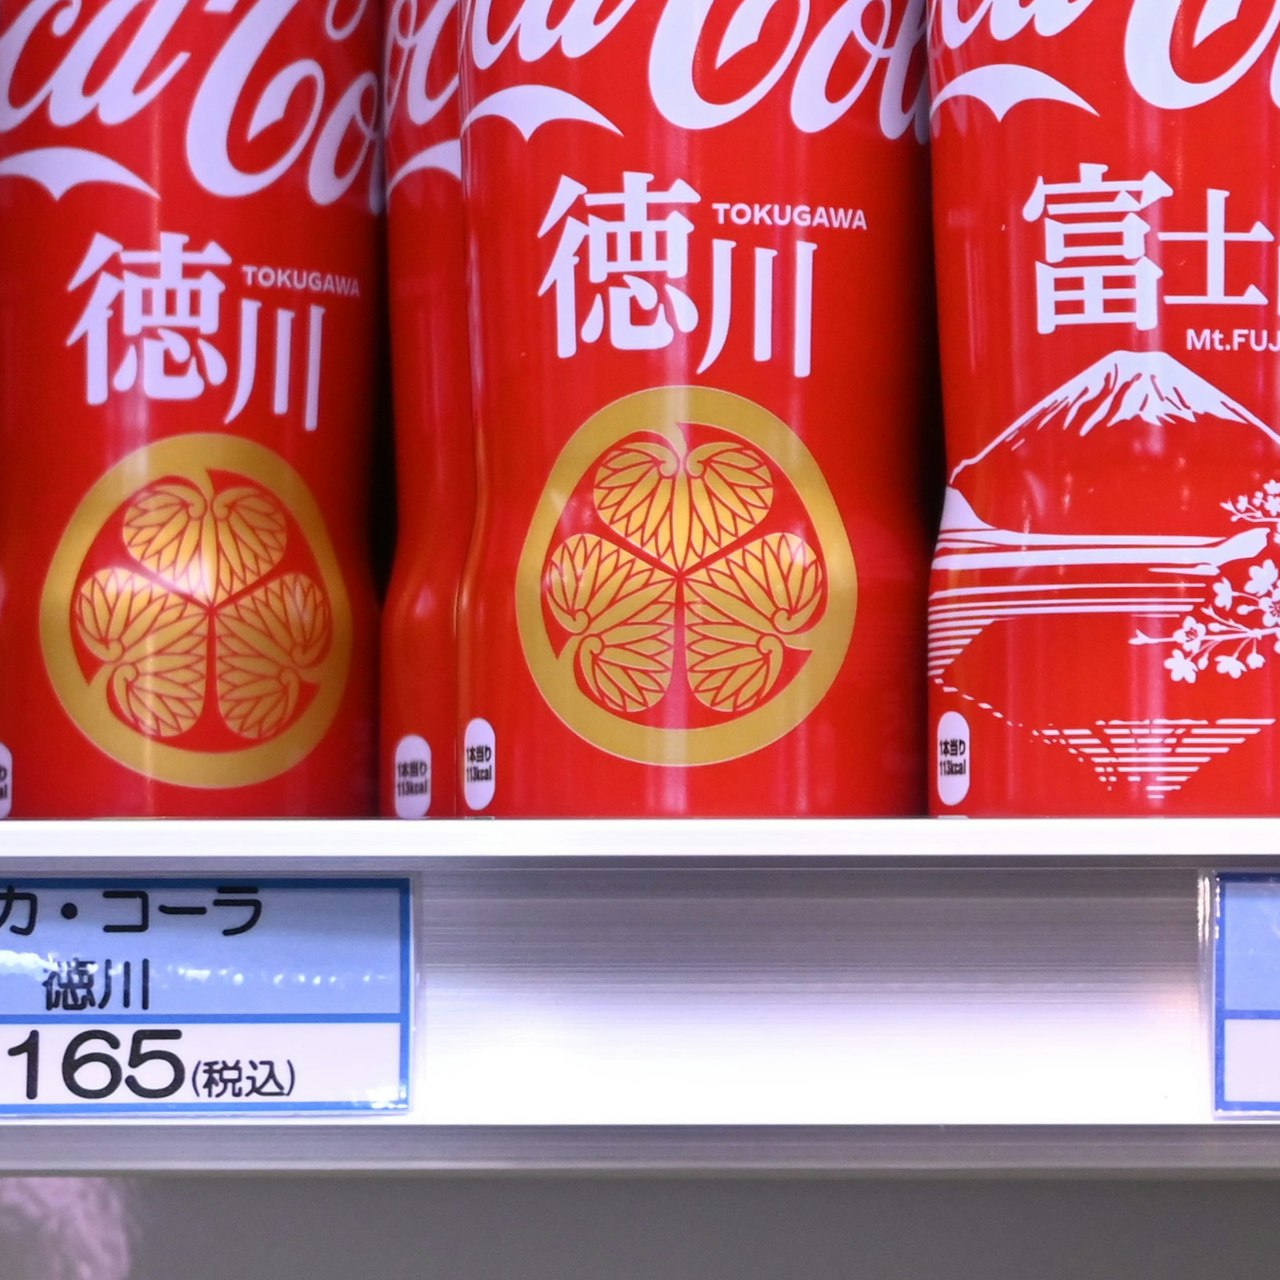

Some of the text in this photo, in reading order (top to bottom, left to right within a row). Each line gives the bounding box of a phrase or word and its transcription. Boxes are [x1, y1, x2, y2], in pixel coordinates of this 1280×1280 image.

[712, 203, 868, 231] TOKUGAWA
[242, 265, 360, 298] TOKUGAWA
[537, 170, 818, 378] 徳川
[66, 231, 325, 432] 徳川
[43, 958, 150, 1010] 徳川
